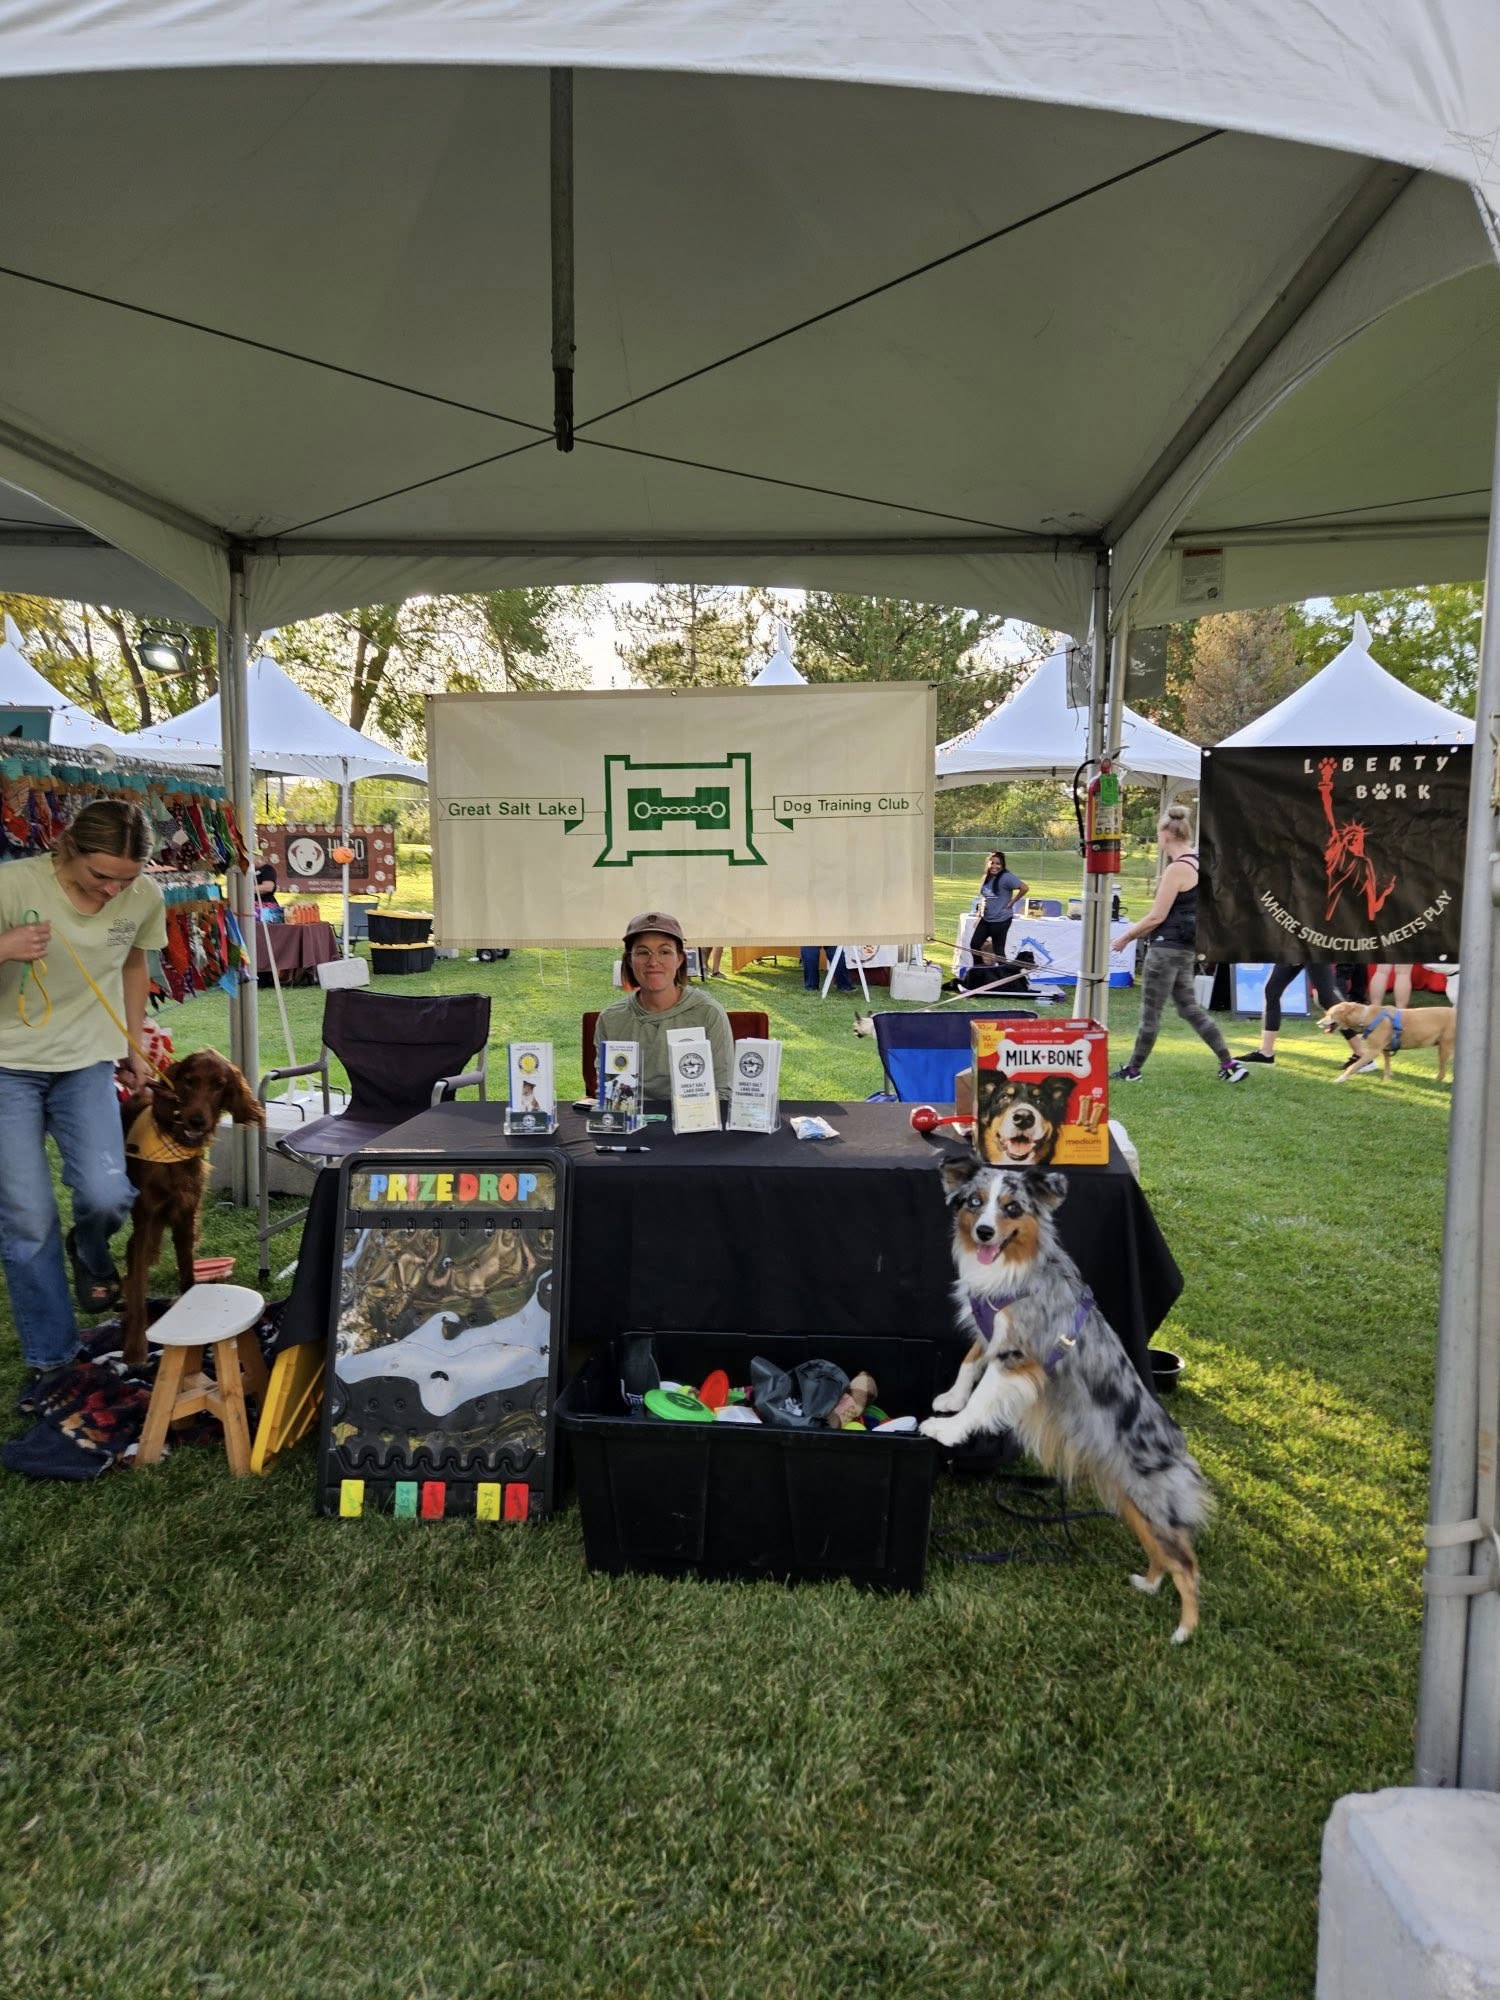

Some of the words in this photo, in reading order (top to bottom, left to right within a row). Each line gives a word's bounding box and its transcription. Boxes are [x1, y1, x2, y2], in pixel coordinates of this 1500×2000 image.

[1303, 756, 1449, 775] LBERTY
[1356, 782, 1432, 800] BRK
[448, 802, 491, 816] Great
[498, 802, 531, 816] Salt
[538, 802, 577, 816] Lake
[783, 800, 812, 814] Dog
[818, 799, 872, 813] Training
[878, 798, 909, 810] Club
[1260, 890, 1301, 933] WHERE
[1298, 926, 1379, 951] STRUCTURE
[1380, 917, 1427, 947] MEETS
[1423, 890, 1452, 921] PLAY
[1065, 1137, 1101, 1145] medium
[369, 1173, 454, 1201] PRIZE
[458, 1173, 538, 1201] DROP
